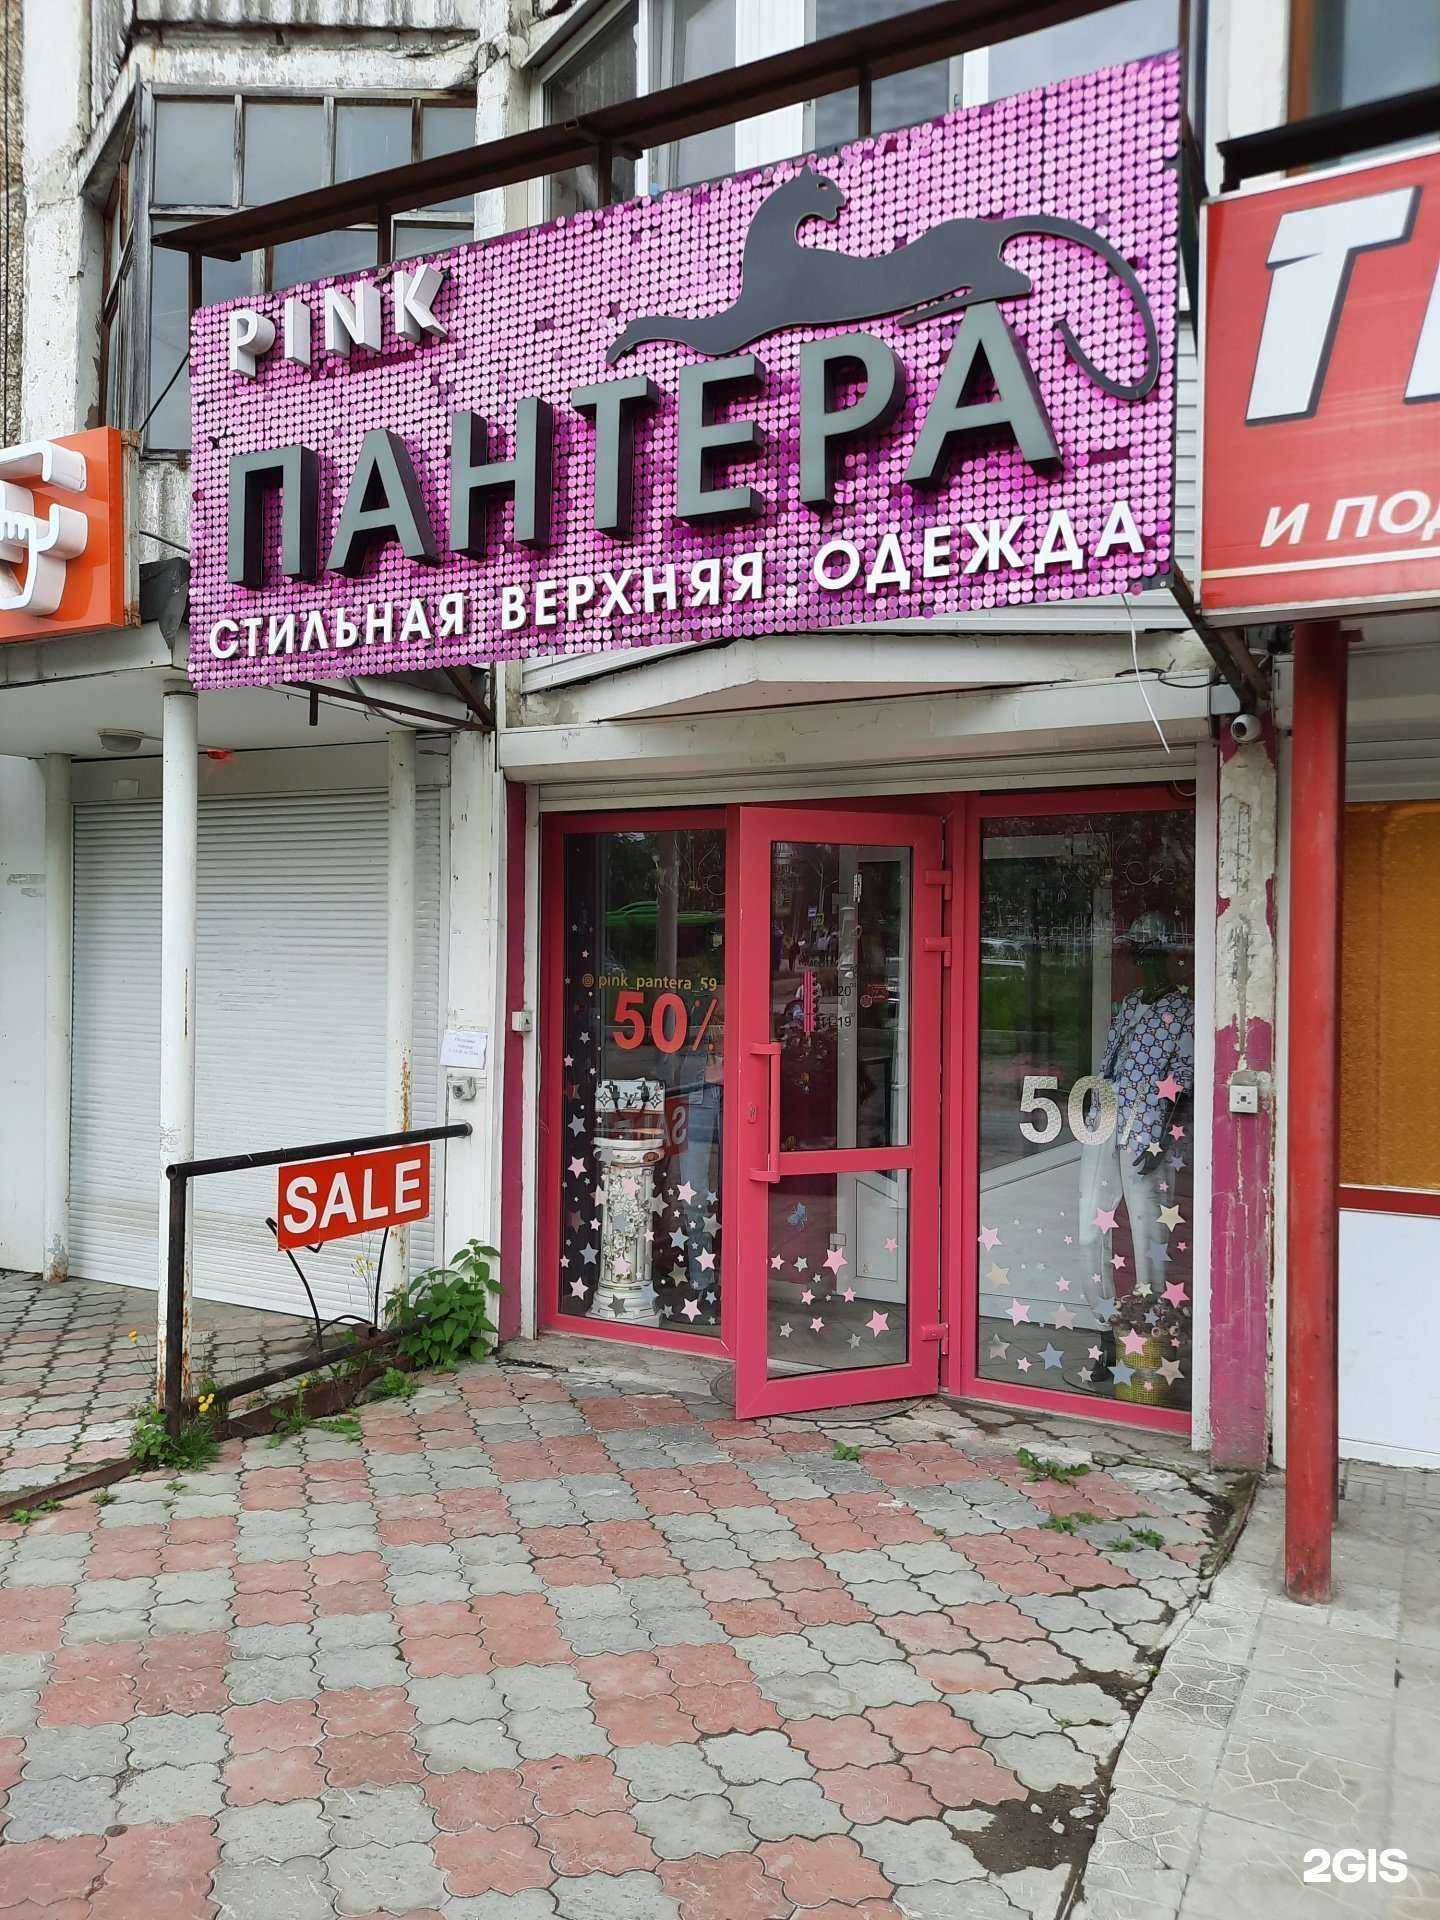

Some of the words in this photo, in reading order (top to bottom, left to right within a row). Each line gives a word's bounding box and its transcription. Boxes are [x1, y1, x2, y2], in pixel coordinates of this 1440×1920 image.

[228, 263, 449, 378] PINK
[1244, 185, 1440, 426] Т
[227, 301, 1063, 589] ПАНТЕРА
[209, 592, 466, 659] СТИЛЬНАЯ
[501, 552, 766, 630] ВЕРХНЯЯ
[813, 500, 1146, 594] ОДЕЖДА
[1260, 503, 1309, 548] И
[282, 1159, 422, 1234] SALE
